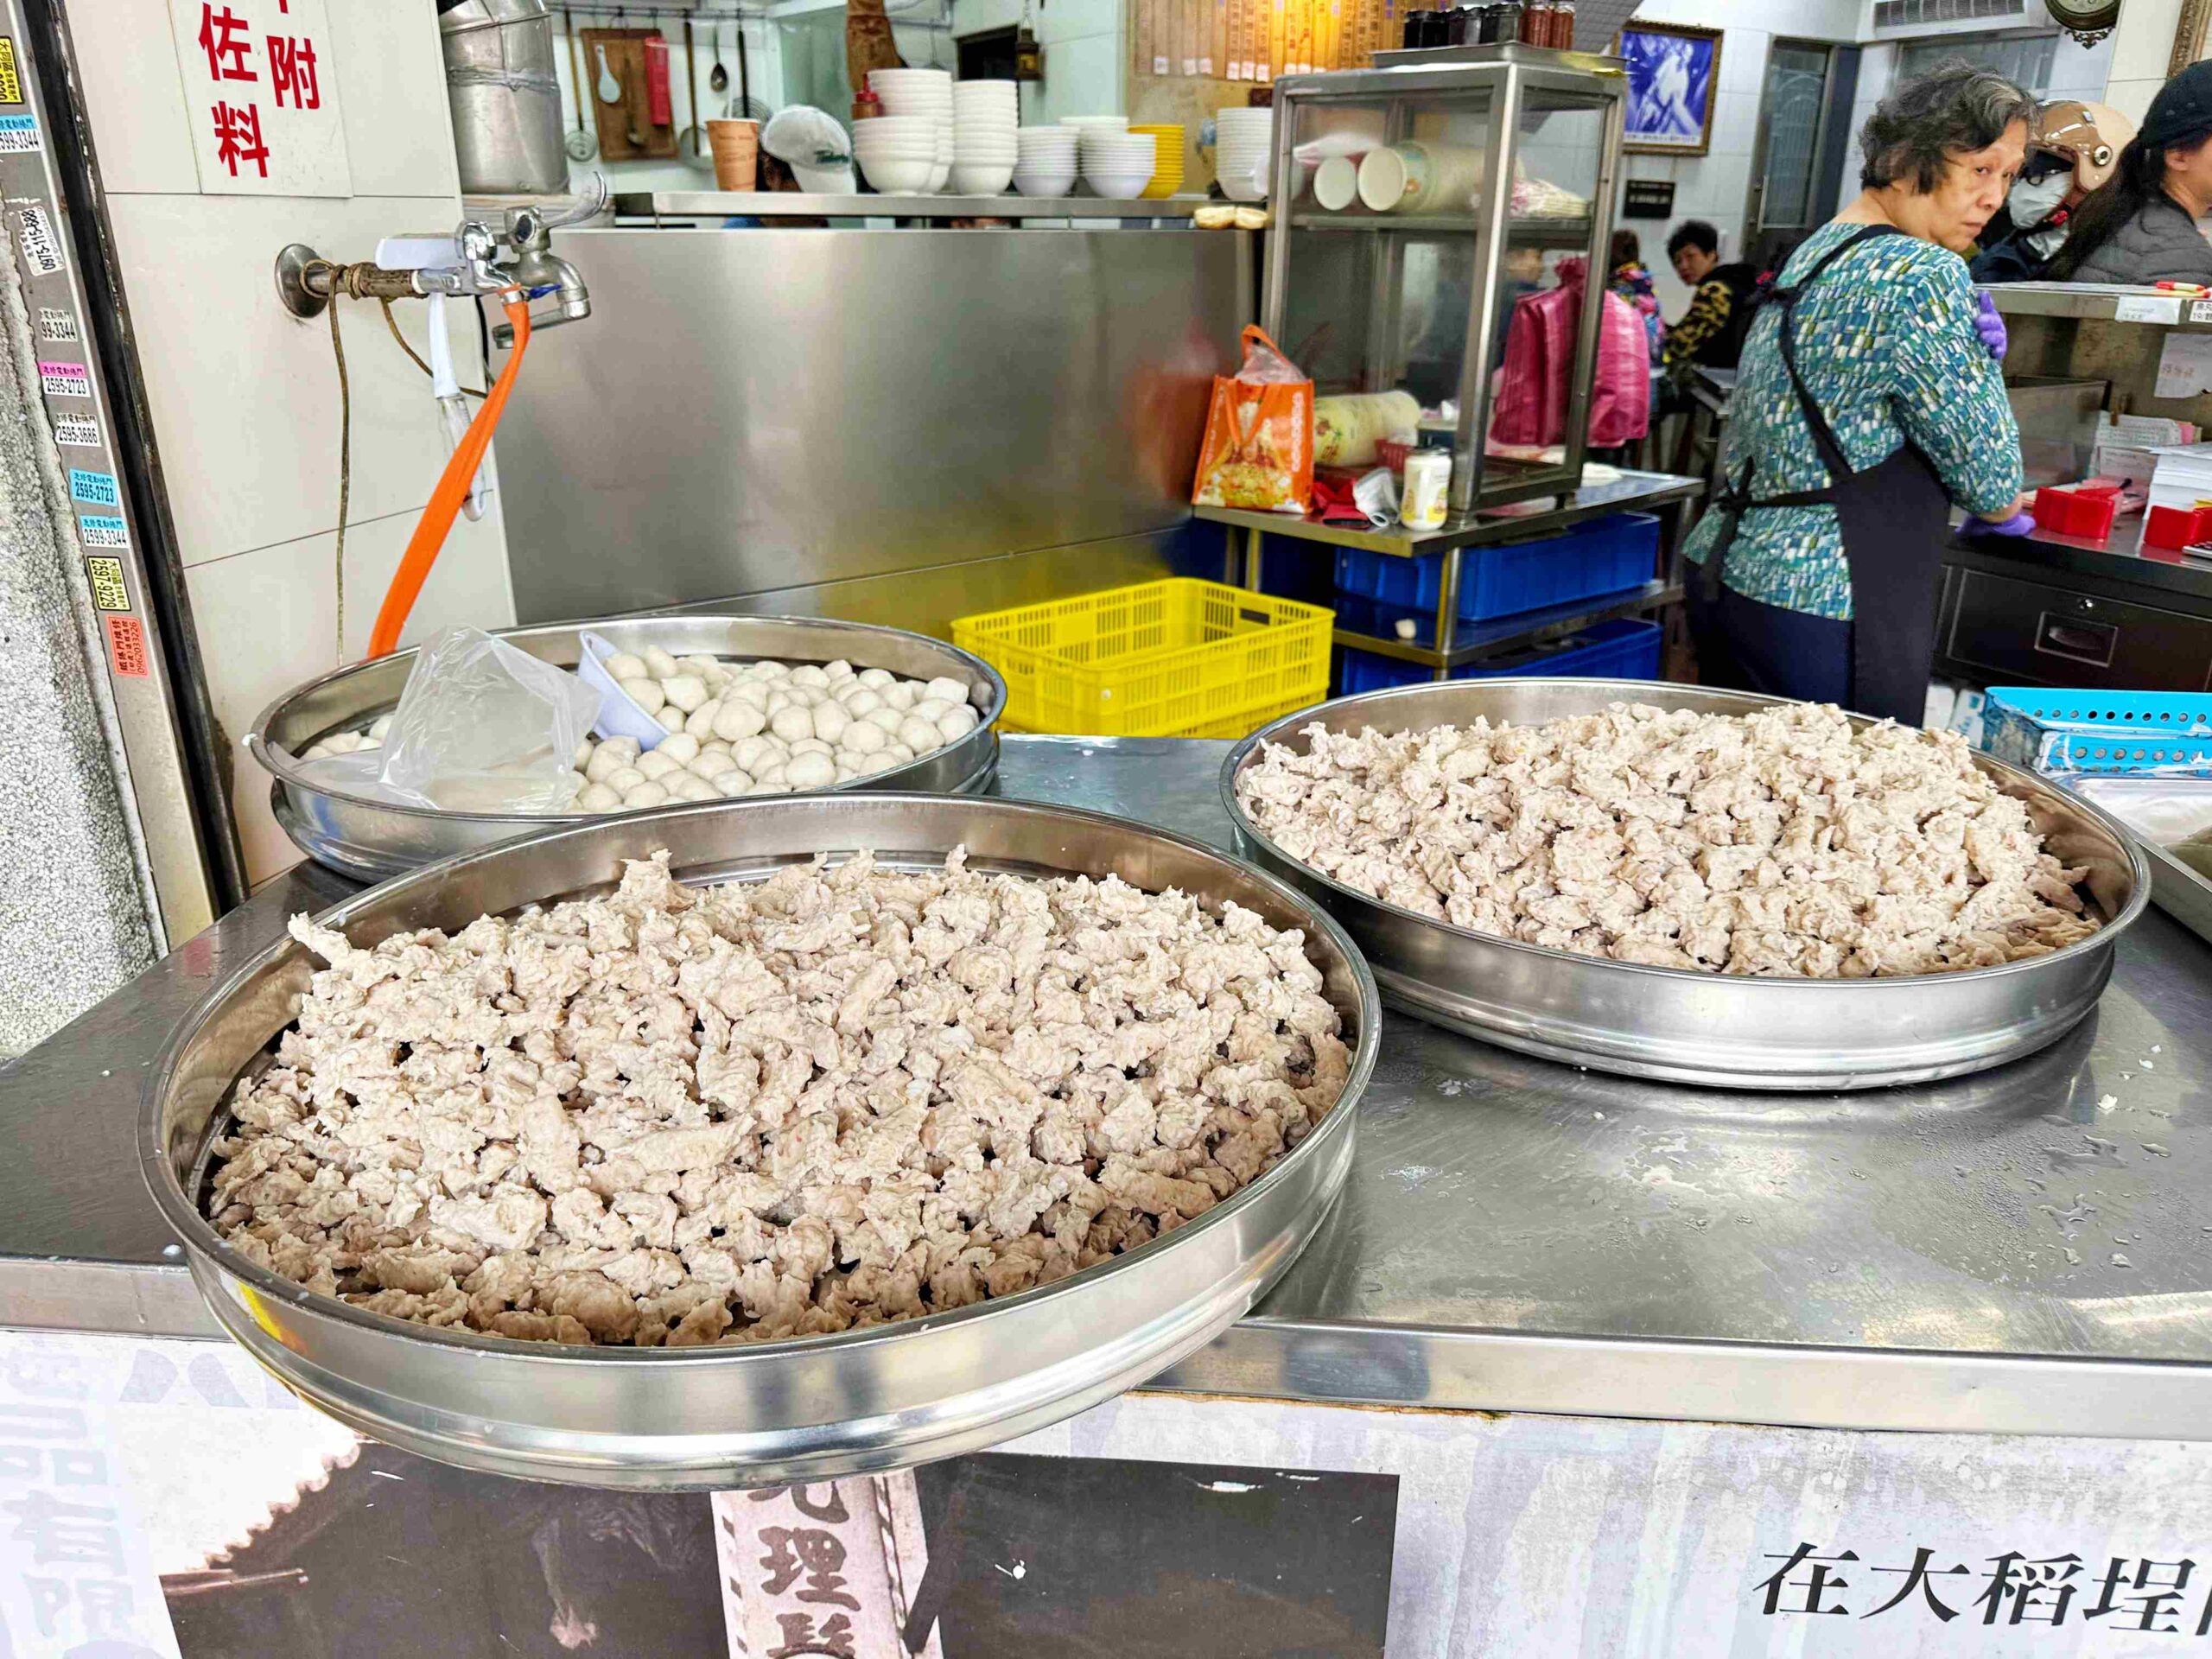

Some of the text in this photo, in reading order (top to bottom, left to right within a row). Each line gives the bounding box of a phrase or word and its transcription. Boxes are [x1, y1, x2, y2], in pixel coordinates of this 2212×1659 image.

[265, 0, 320, 109] 附
[198, 2, 270, 178] 佐料
[46, 377, 86, 395] 2595-2723
[57, 426, 98, 444] 2595-3686
[75, 482, 115, 503] 2595-2723
[85, 529, 127, 545] 2599-3344
[90, 559, 117, 608] 2597-9229
[129, 621, 145, 674] 0962033226
[1752, 1541, 2212, 1637] 在大稻埕
